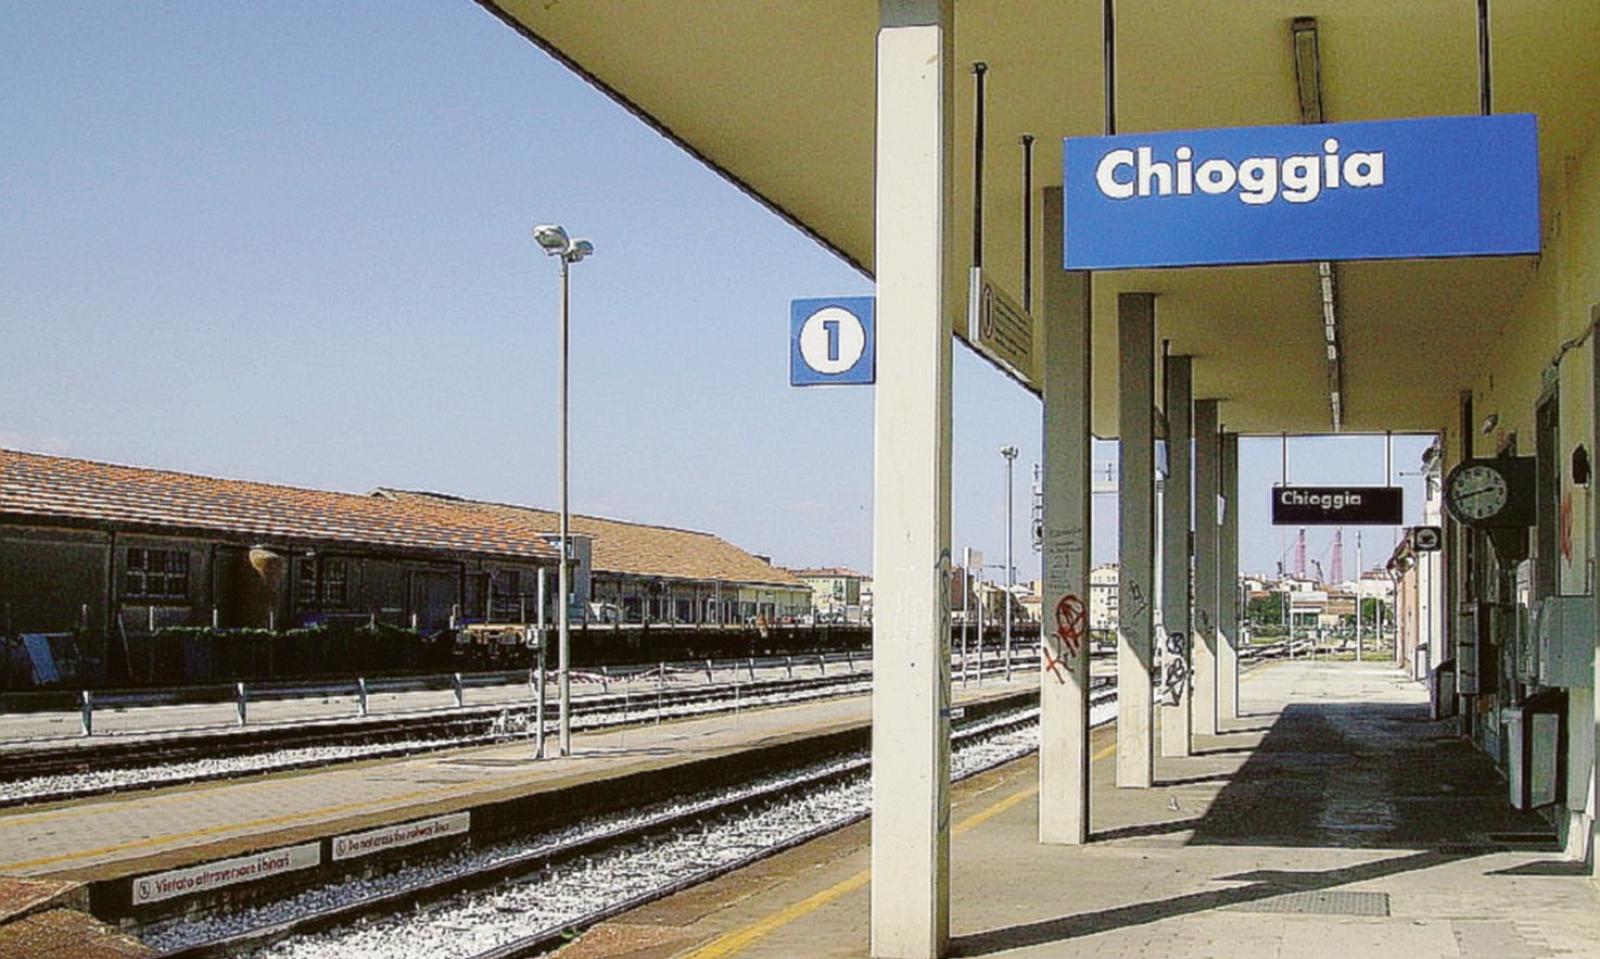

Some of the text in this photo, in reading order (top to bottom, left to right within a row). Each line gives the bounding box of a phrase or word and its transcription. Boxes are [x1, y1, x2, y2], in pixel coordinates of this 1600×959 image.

[1096, 138, 1384, 204] Chioggia
[823, 320, 840, 361] 1
[1281, 490, 1361, 509] Chioggia
[155, 878, 194, 894] Vietato
[195, 865, 256, 885] attraversare
[262, 853, 290, 872] binari
